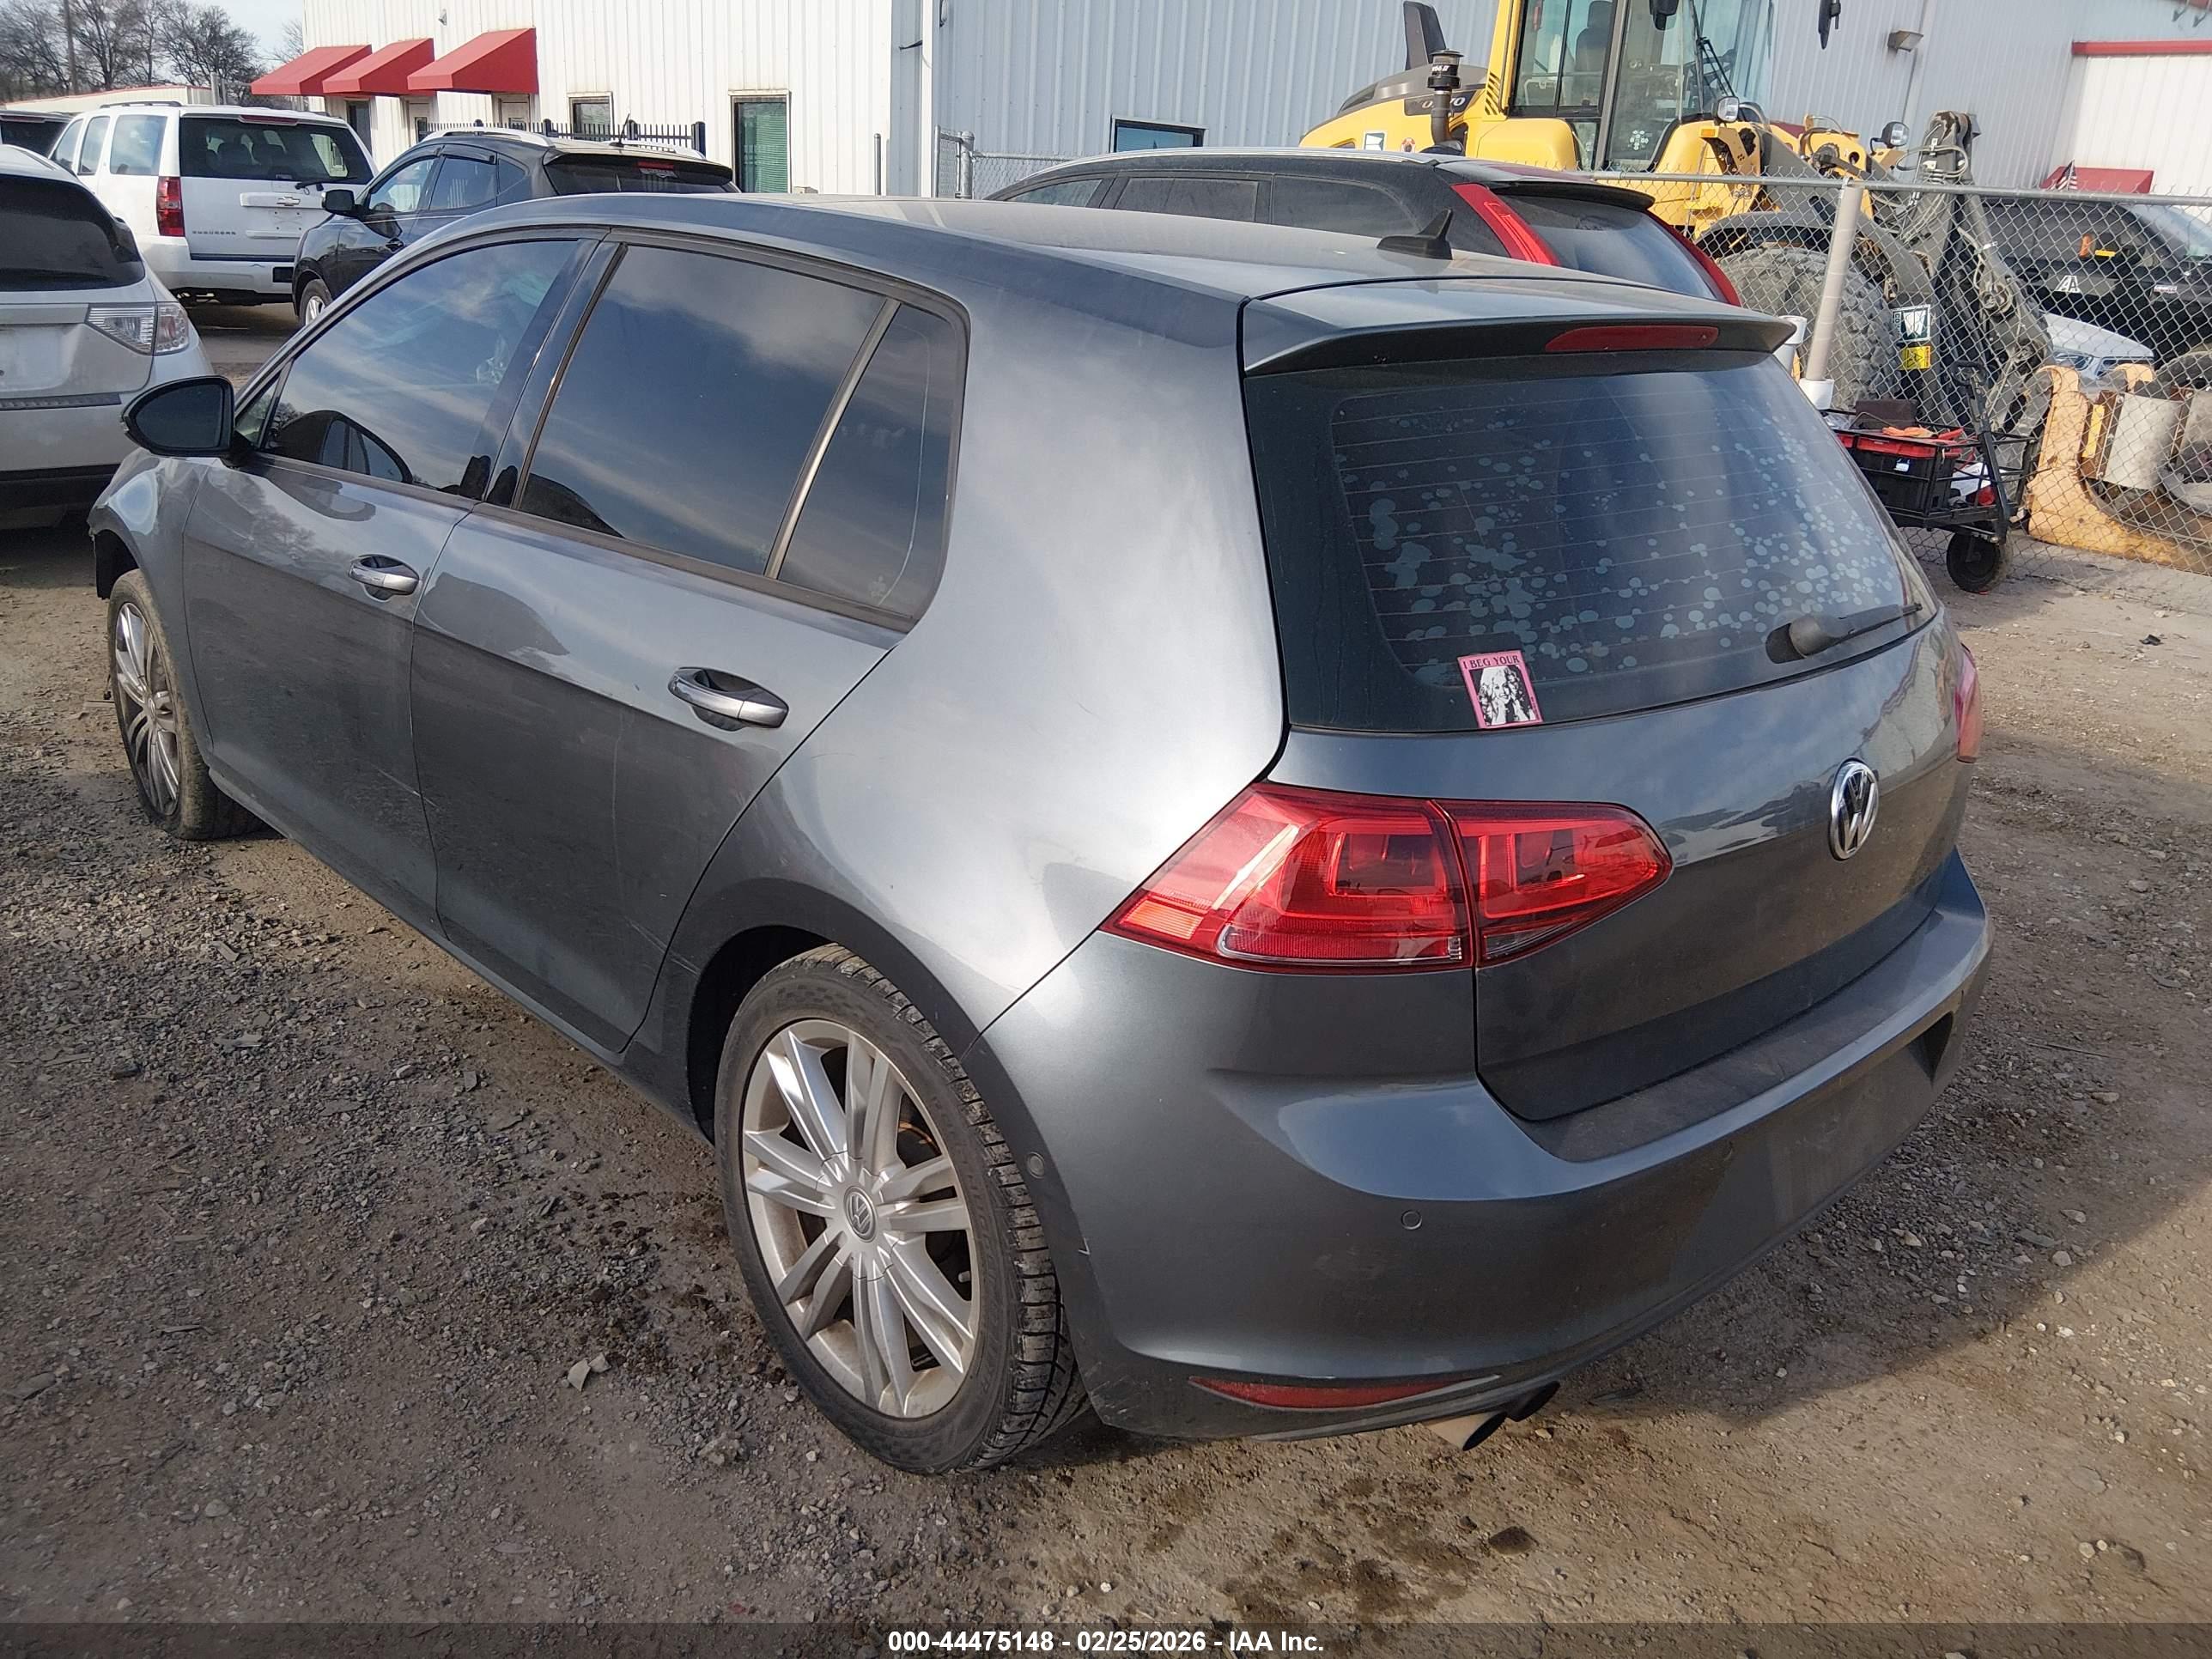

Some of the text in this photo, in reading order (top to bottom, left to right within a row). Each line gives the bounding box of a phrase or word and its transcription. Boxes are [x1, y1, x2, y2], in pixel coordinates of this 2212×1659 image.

[1463, 655, 1520, 670] I BEG YOUR
